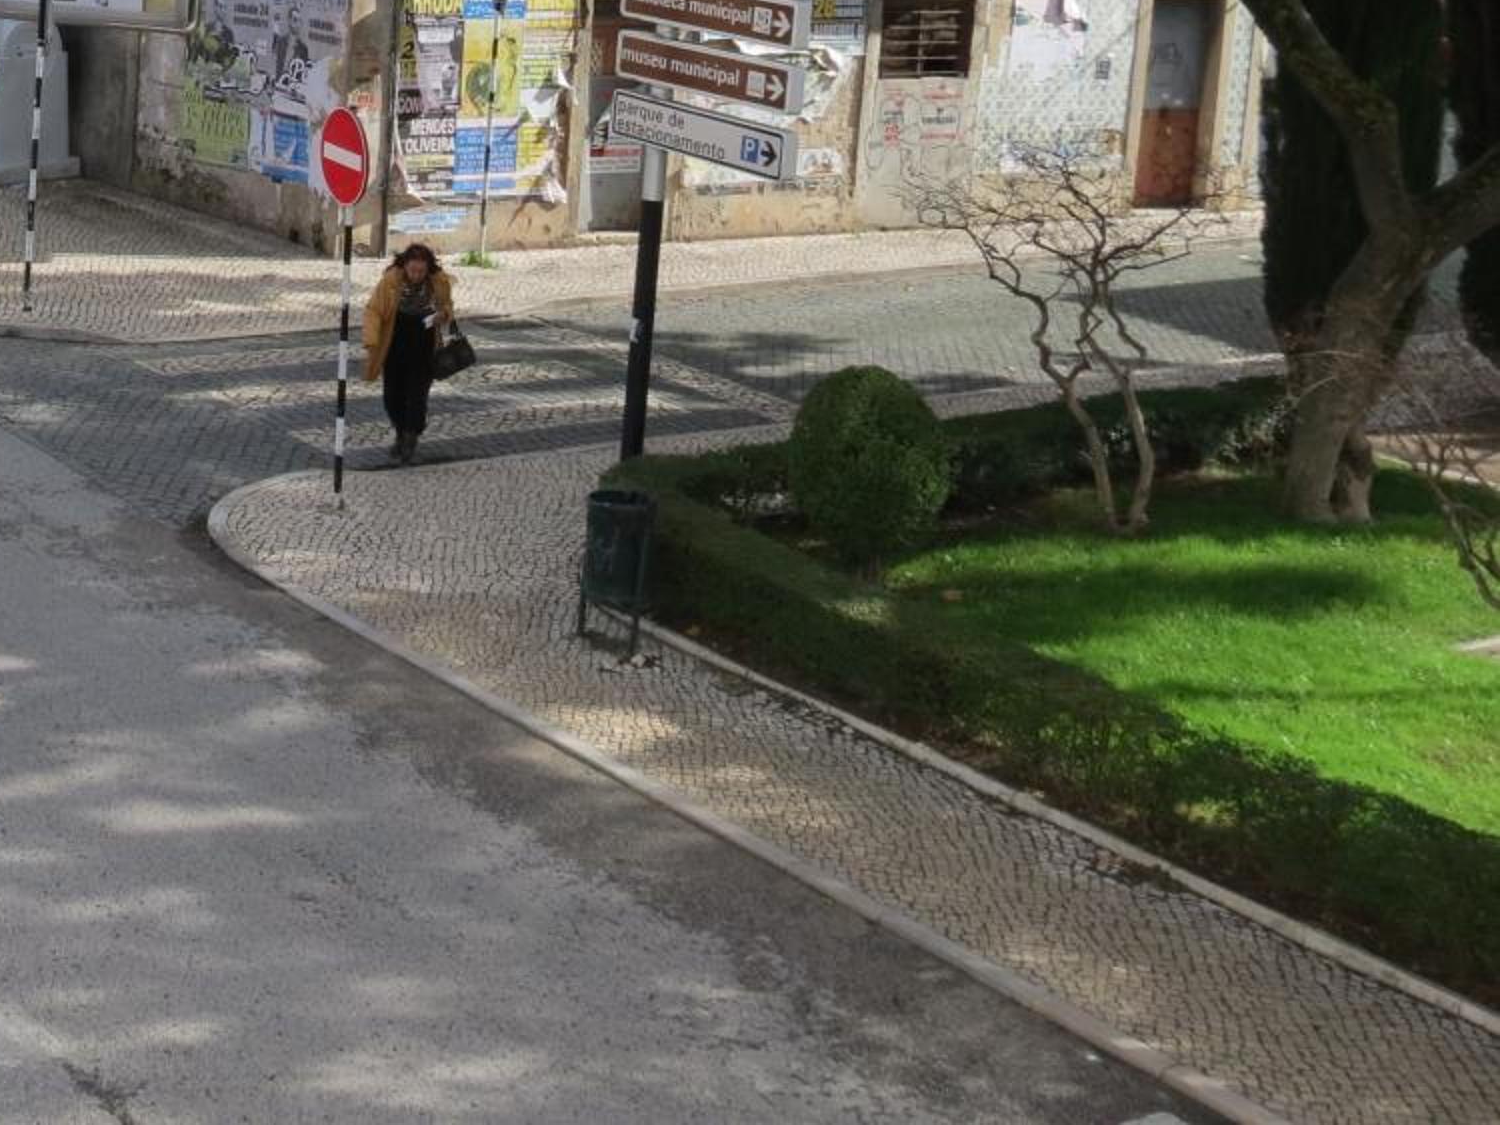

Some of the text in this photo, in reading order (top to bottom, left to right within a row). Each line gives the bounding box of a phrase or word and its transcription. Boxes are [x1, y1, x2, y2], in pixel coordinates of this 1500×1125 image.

[622, 46, 740, 86] museu municipal
[410, 118, 455, 136] MENDES
[617, 99, 685, 129] parque de
[617, 117, 725, 159] estacionamento
[744, 140, 757, 159] P
